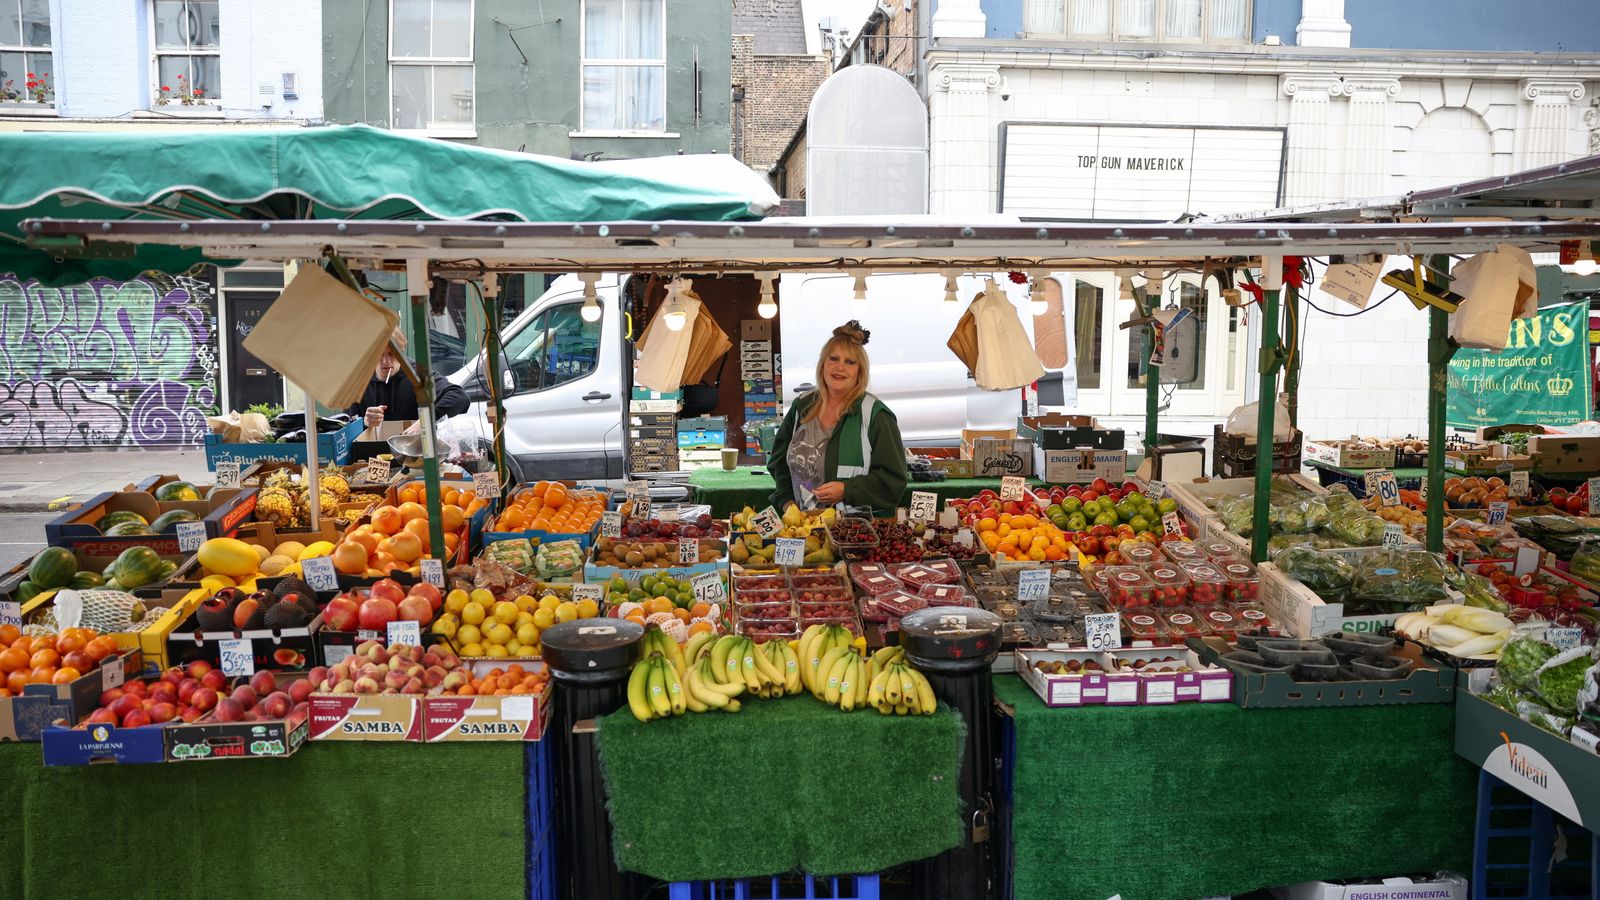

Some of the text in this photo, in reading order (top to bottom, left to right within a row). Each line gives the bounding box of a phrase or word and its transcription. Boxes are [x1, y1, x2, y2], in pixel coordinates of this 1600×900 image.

[1077, 155, 1184, 171] TOP GUN MAVERICK
[1505, 312, 1575, 348] N'S
[1472, 356, 1480, 368] in
[1483, 355, 1495, 368] the
[1498, 355, 1537, 368] tradition
[1541, 353, 1552, 366] of
[1093, 455, 1122, 463] OMAINE
[1341, 619, 1389, 634] SPIN
[343, 721, 404, 733] SAMBA
[460, 723, 521, 734] SAMBA
[1499, 731, 1547, 789] Videau
[1350, 891, 1450, 900] ENGLISH CONTINENTAL
